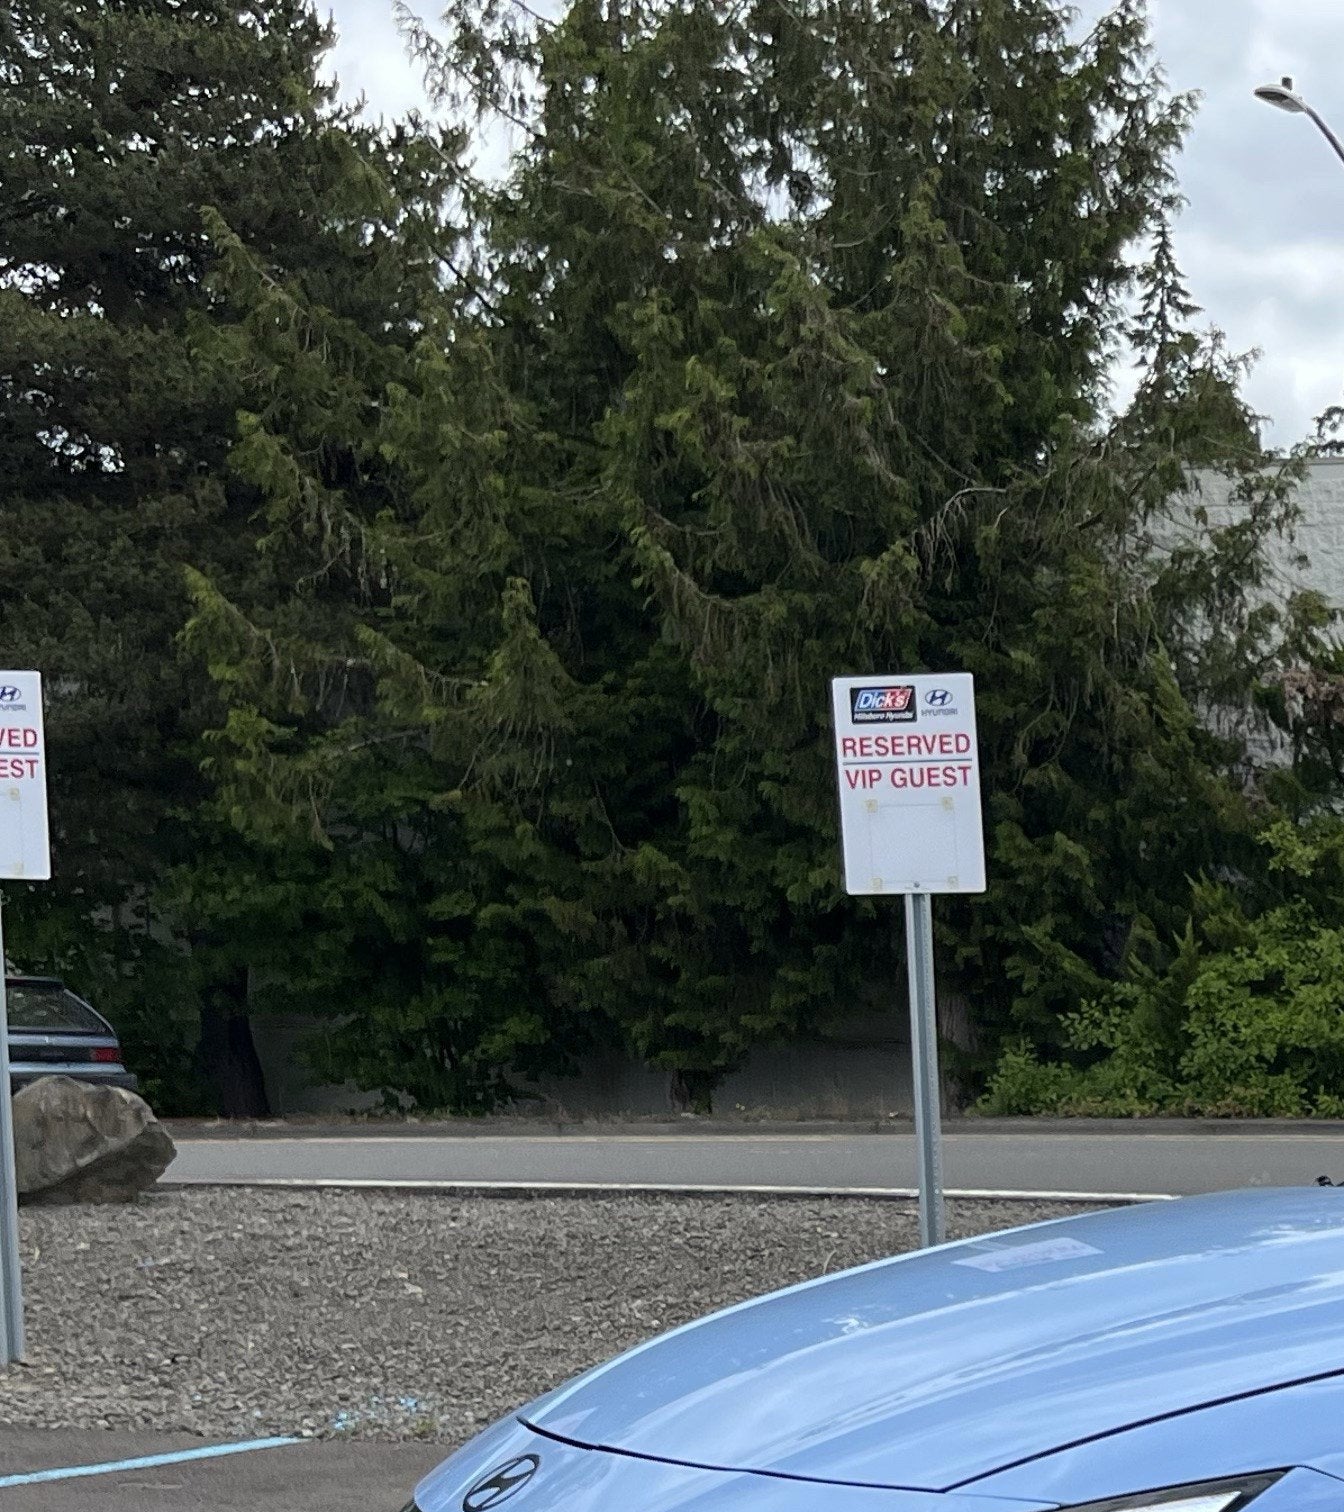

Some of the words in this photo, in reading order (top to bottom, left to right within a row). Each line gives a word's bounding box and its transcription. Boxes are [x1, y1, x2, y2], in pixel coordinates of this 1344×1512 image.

[842, 733, 971, 758] RESERVED
[845, 769, 882, 790] VIP
[891, 766, 972, 788] GUEST
